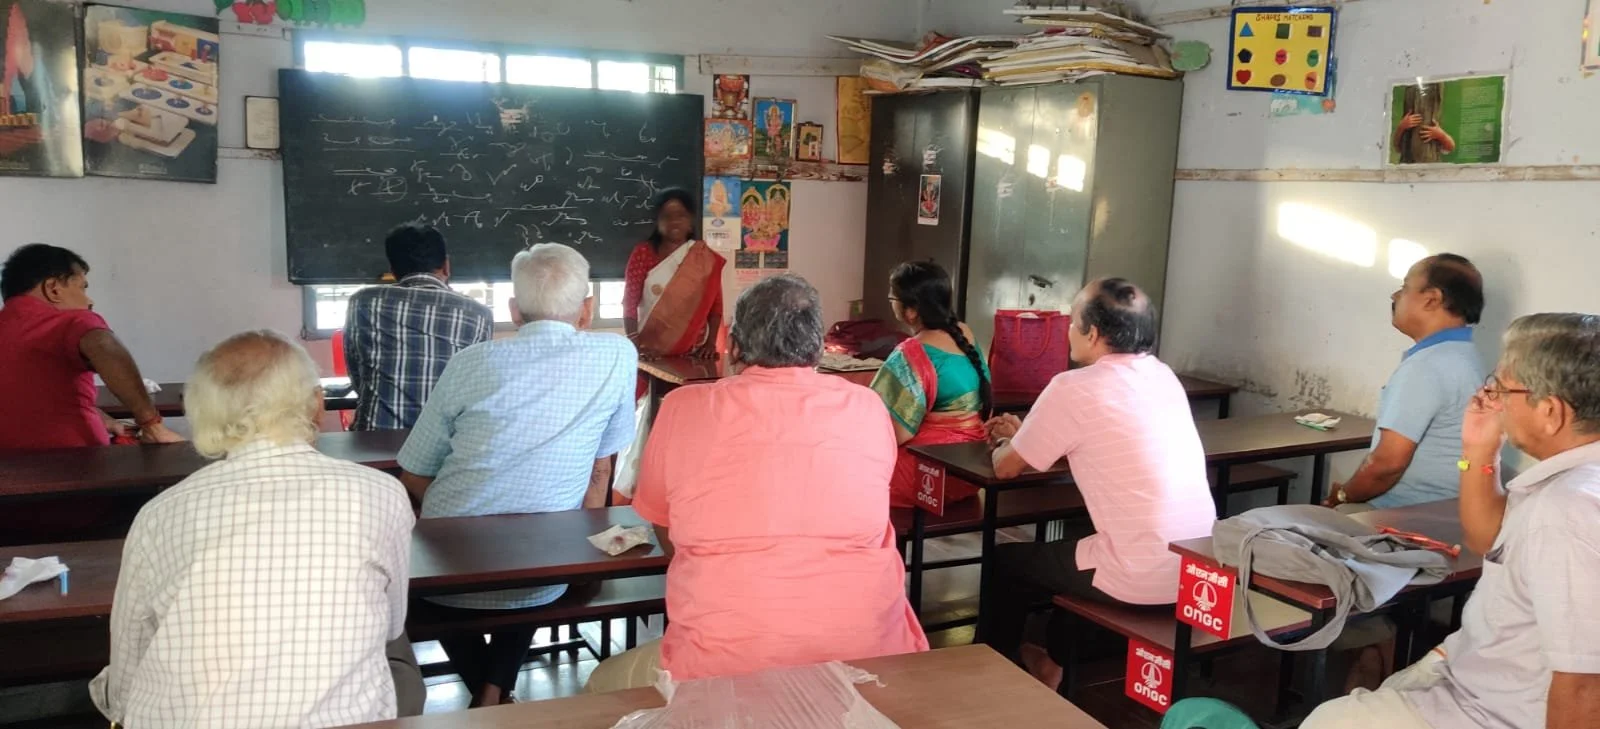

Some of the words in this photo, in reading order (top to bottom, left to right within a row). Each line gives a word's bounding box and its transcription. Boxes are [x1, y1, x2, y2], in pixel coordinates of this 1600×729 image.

[917, 491, 938, 507] ONGC
[1183, 605, 1223, 631] ONGC
[1134, 681, 1168, 706] ONGC
